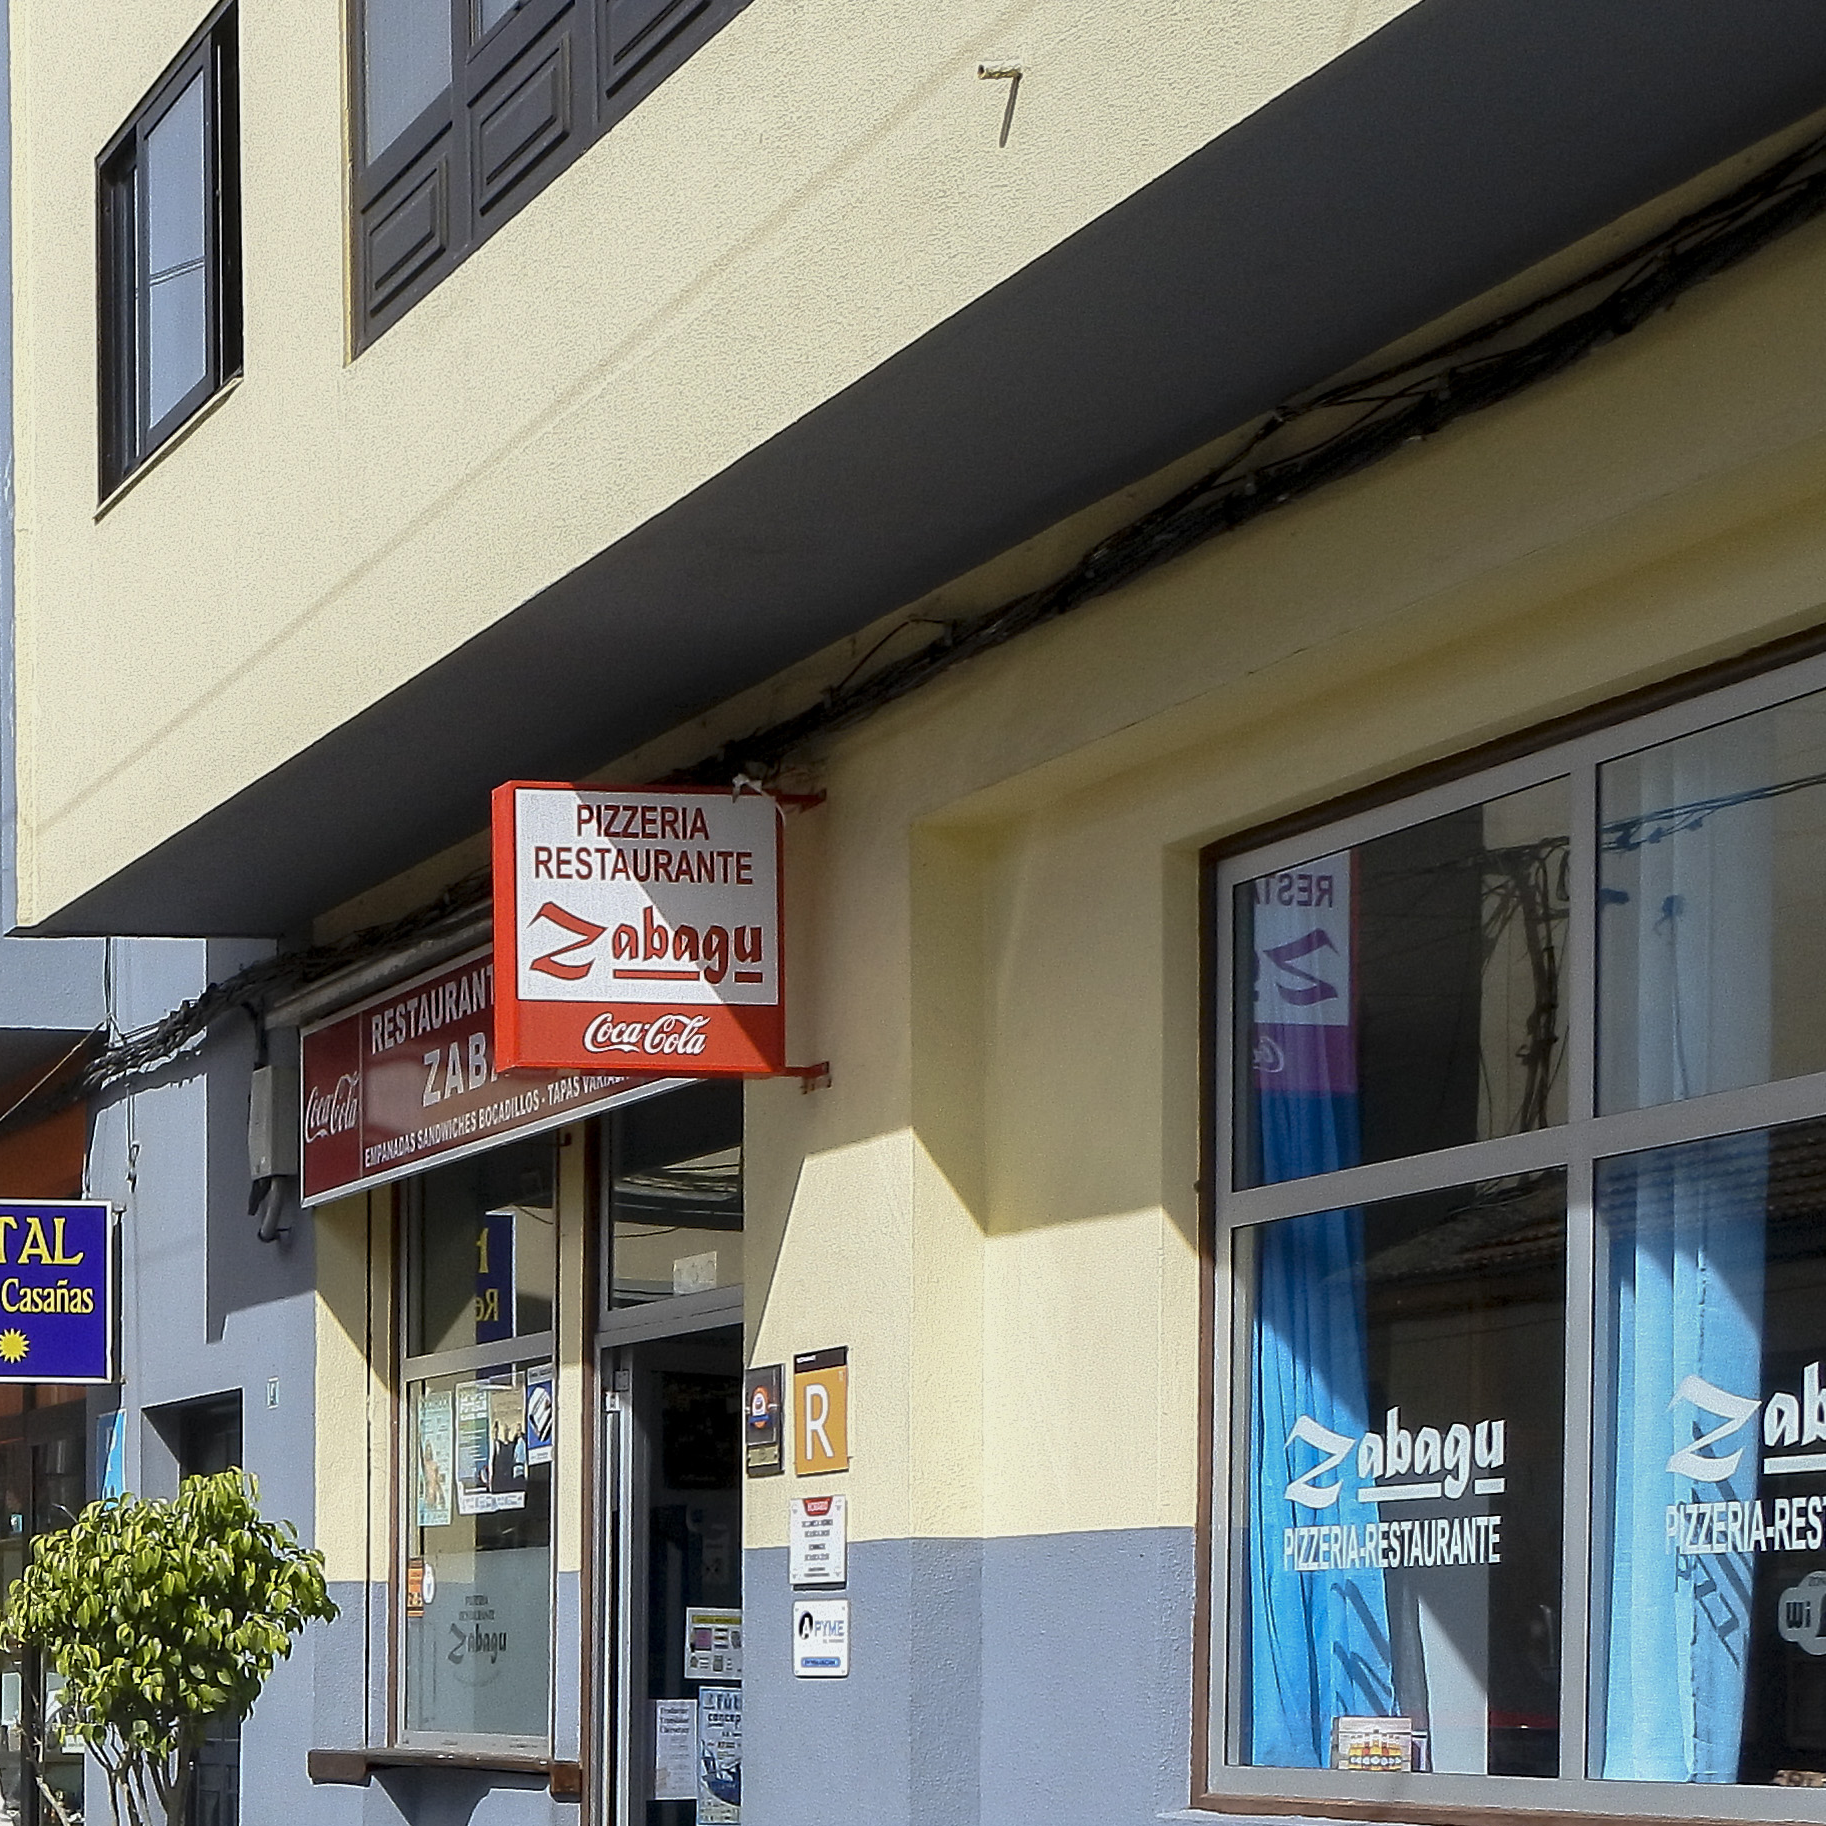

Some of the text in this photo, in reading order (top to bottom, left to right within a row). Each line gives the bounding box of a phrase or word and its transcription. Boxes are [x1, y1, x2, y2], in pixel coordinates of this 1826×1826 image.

[576, 803, 710, 841] PIZZERIA
[534, 845, 754, 885] RESTAURANTE
[526, 900, 764, 985] Zabagu
[371, 965, 495, 1055] RESTAURANT
[583, 1011, 711, 1055] Coca-Cola
[422, 1031, 498, 1108] ZAB
[364, 1132, 416, 1168] EMPANADAS
[417, 1110, 477, 1149] SANDWICHES
[478, 1089, 540, 1129] BOCADILLOS
[547, 1076, 580, 1106] TAPAS
[1, 1278, 94, 1314] Casañas
[804, 1383, 834, 1461] R
[1283, 1405, 1506, 1510] Zabagu
[1666, 1361, 1826, 1483] Zab
[1283, 1515, 1502, 1572] PIZZERIA-RESTAURANTE
[1666, 1494, 1826, 1556] PIZZERIA-RES
